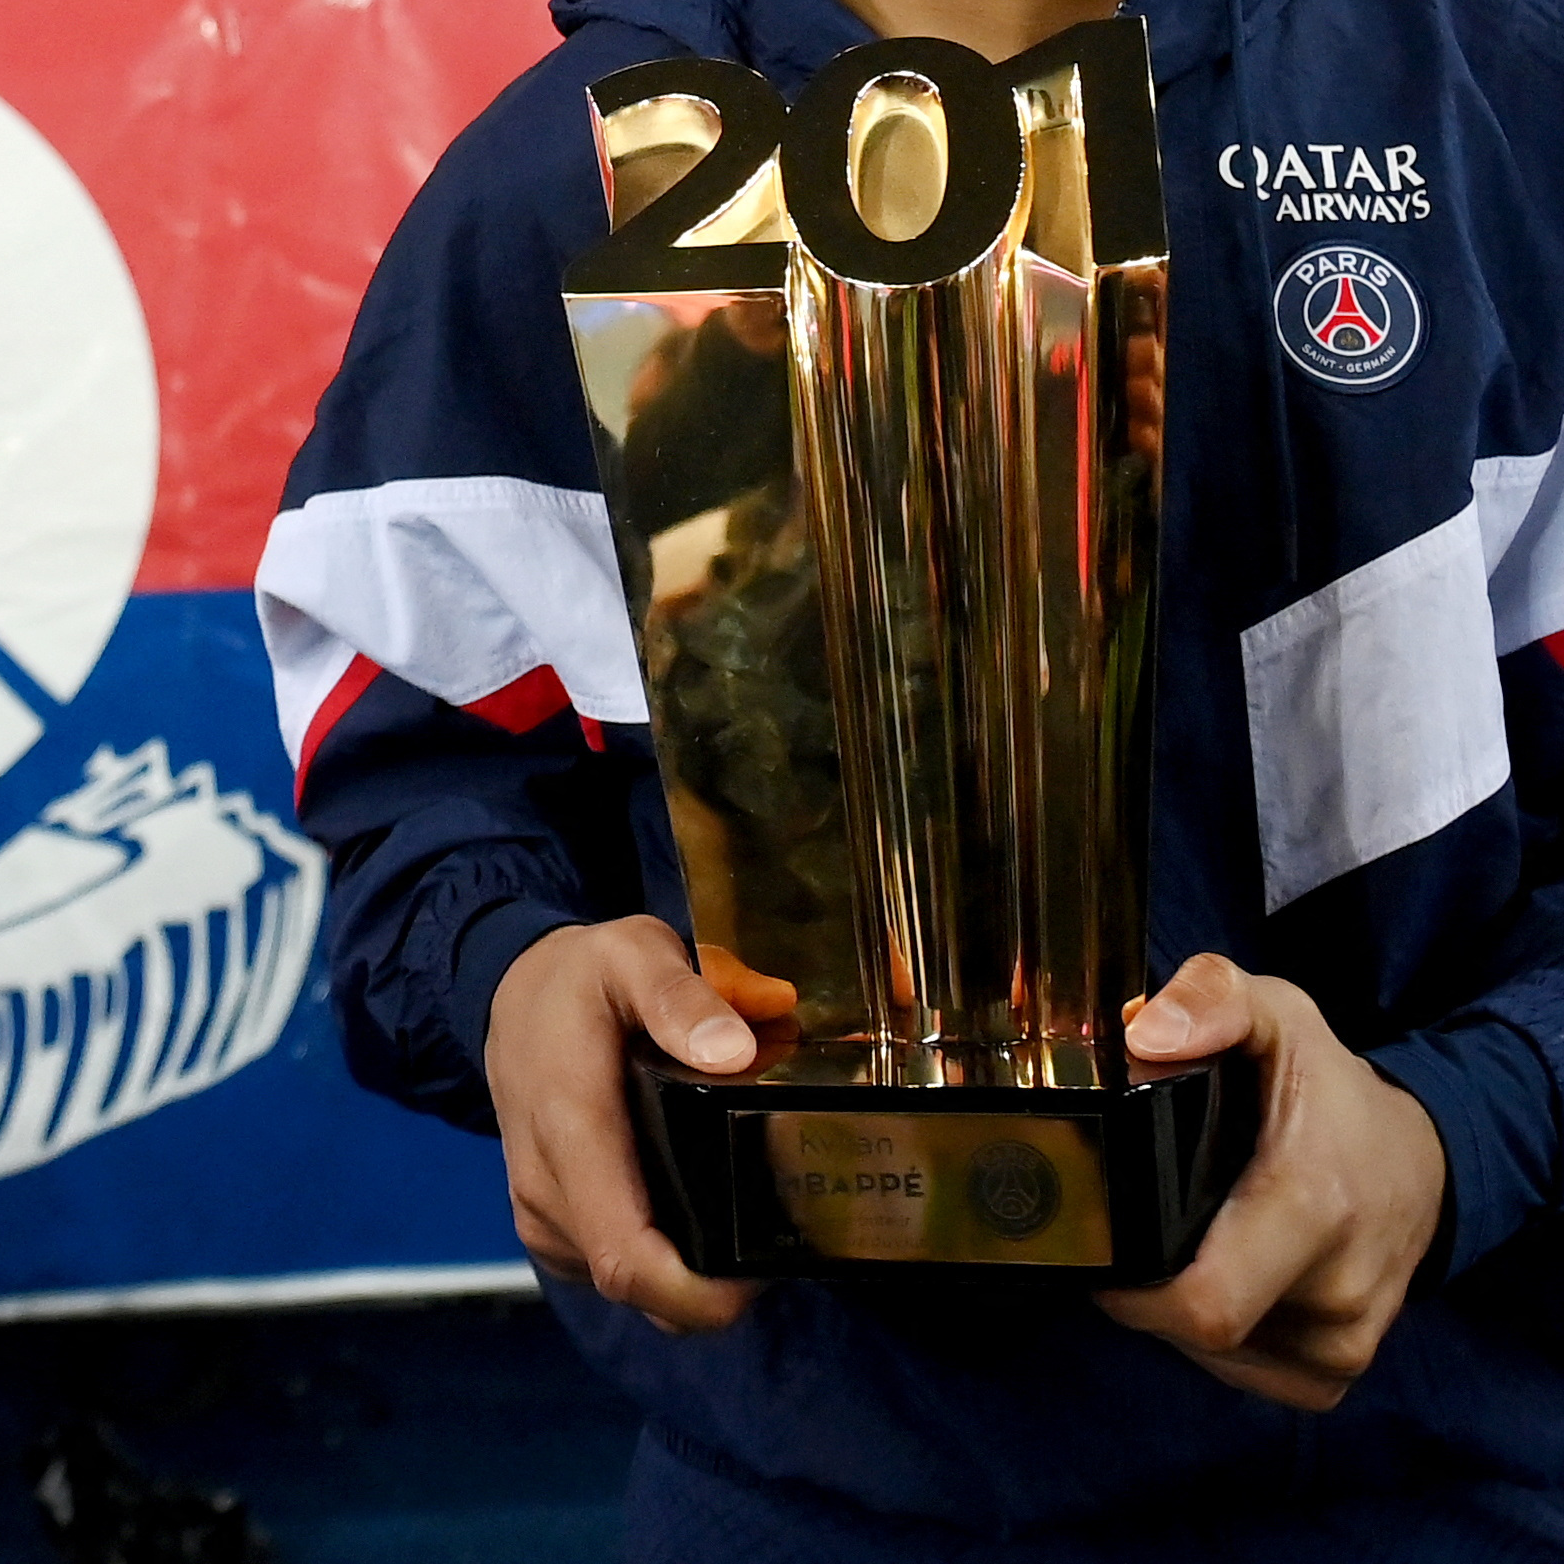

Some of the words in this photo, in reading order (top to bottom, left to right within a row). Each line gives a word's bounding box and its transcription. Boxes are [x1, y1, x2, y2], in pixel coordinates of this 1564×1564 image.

[562, 16, 1170, 294] 201
[1217, 143, 1427, 201] QATAR
[1275, 189, 1432, 224] AIRWAYS
[1294, 252, 1393, 289] PARIS
